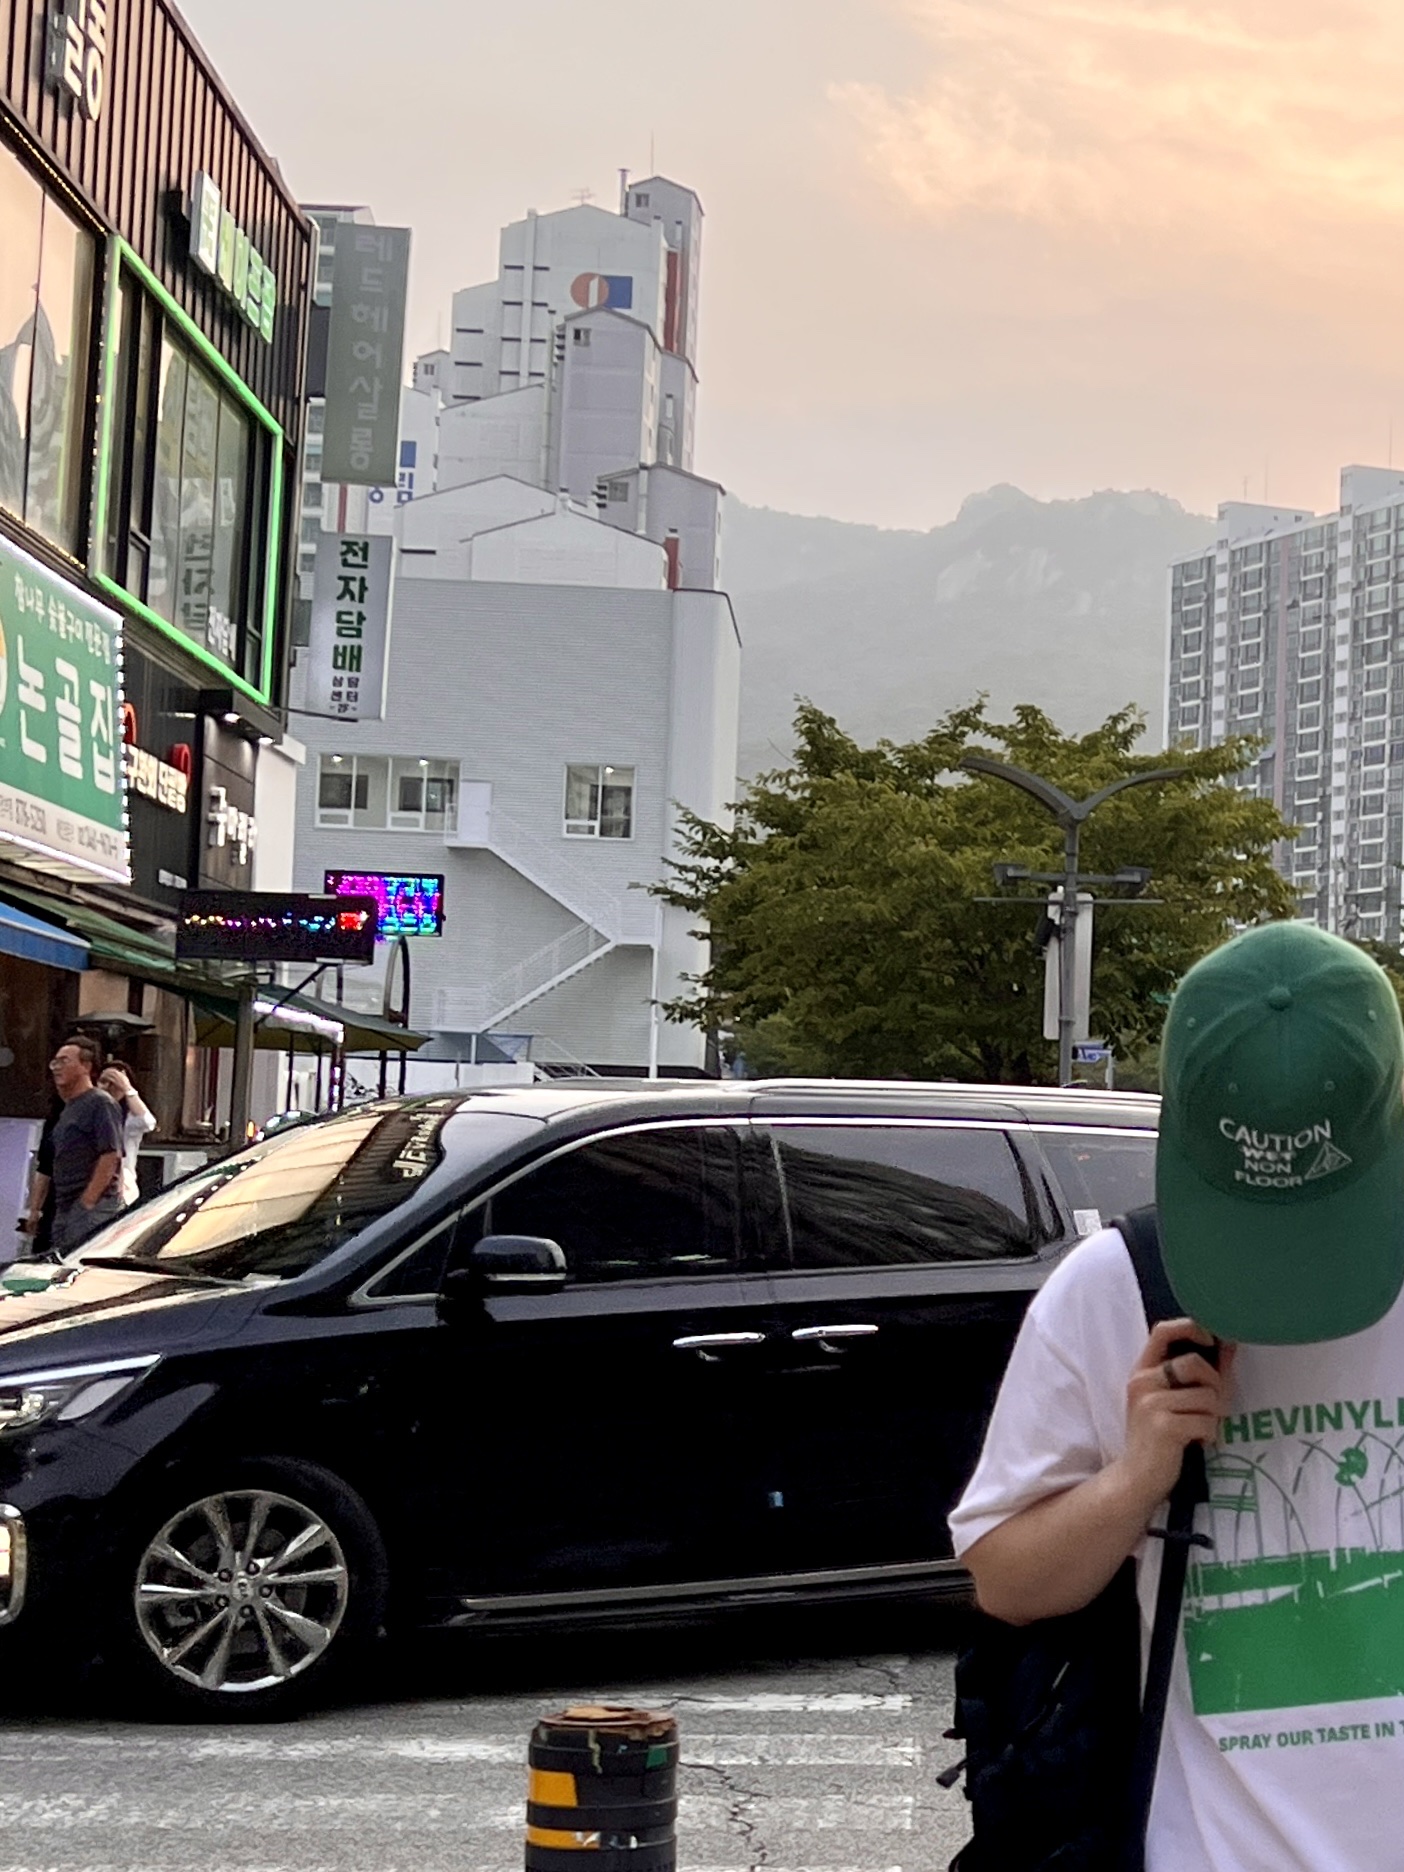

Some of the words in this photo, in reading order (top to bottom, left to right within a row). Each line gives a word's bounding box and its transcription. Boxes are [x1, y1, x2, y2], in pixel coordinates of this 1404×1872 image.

[332, 540, 370, 673] 전자담배
[16, 633, 116, 795] 논골집
[1219, 1117, 1333, 1152] CAUTION
[1241, 1145, 1296, 1161] WET
[1244, 1160, 1292, 1174] NON
[1234, 1170, 1303, 1188] FLOOR
[1218, 1733, 1272, 1753] SPRAY
[1276, 1730, 1314, 1748] OUR
[1317, 1723, 1371, 1743] TASTE
[1375, 1720, 1395, 1738] IN
